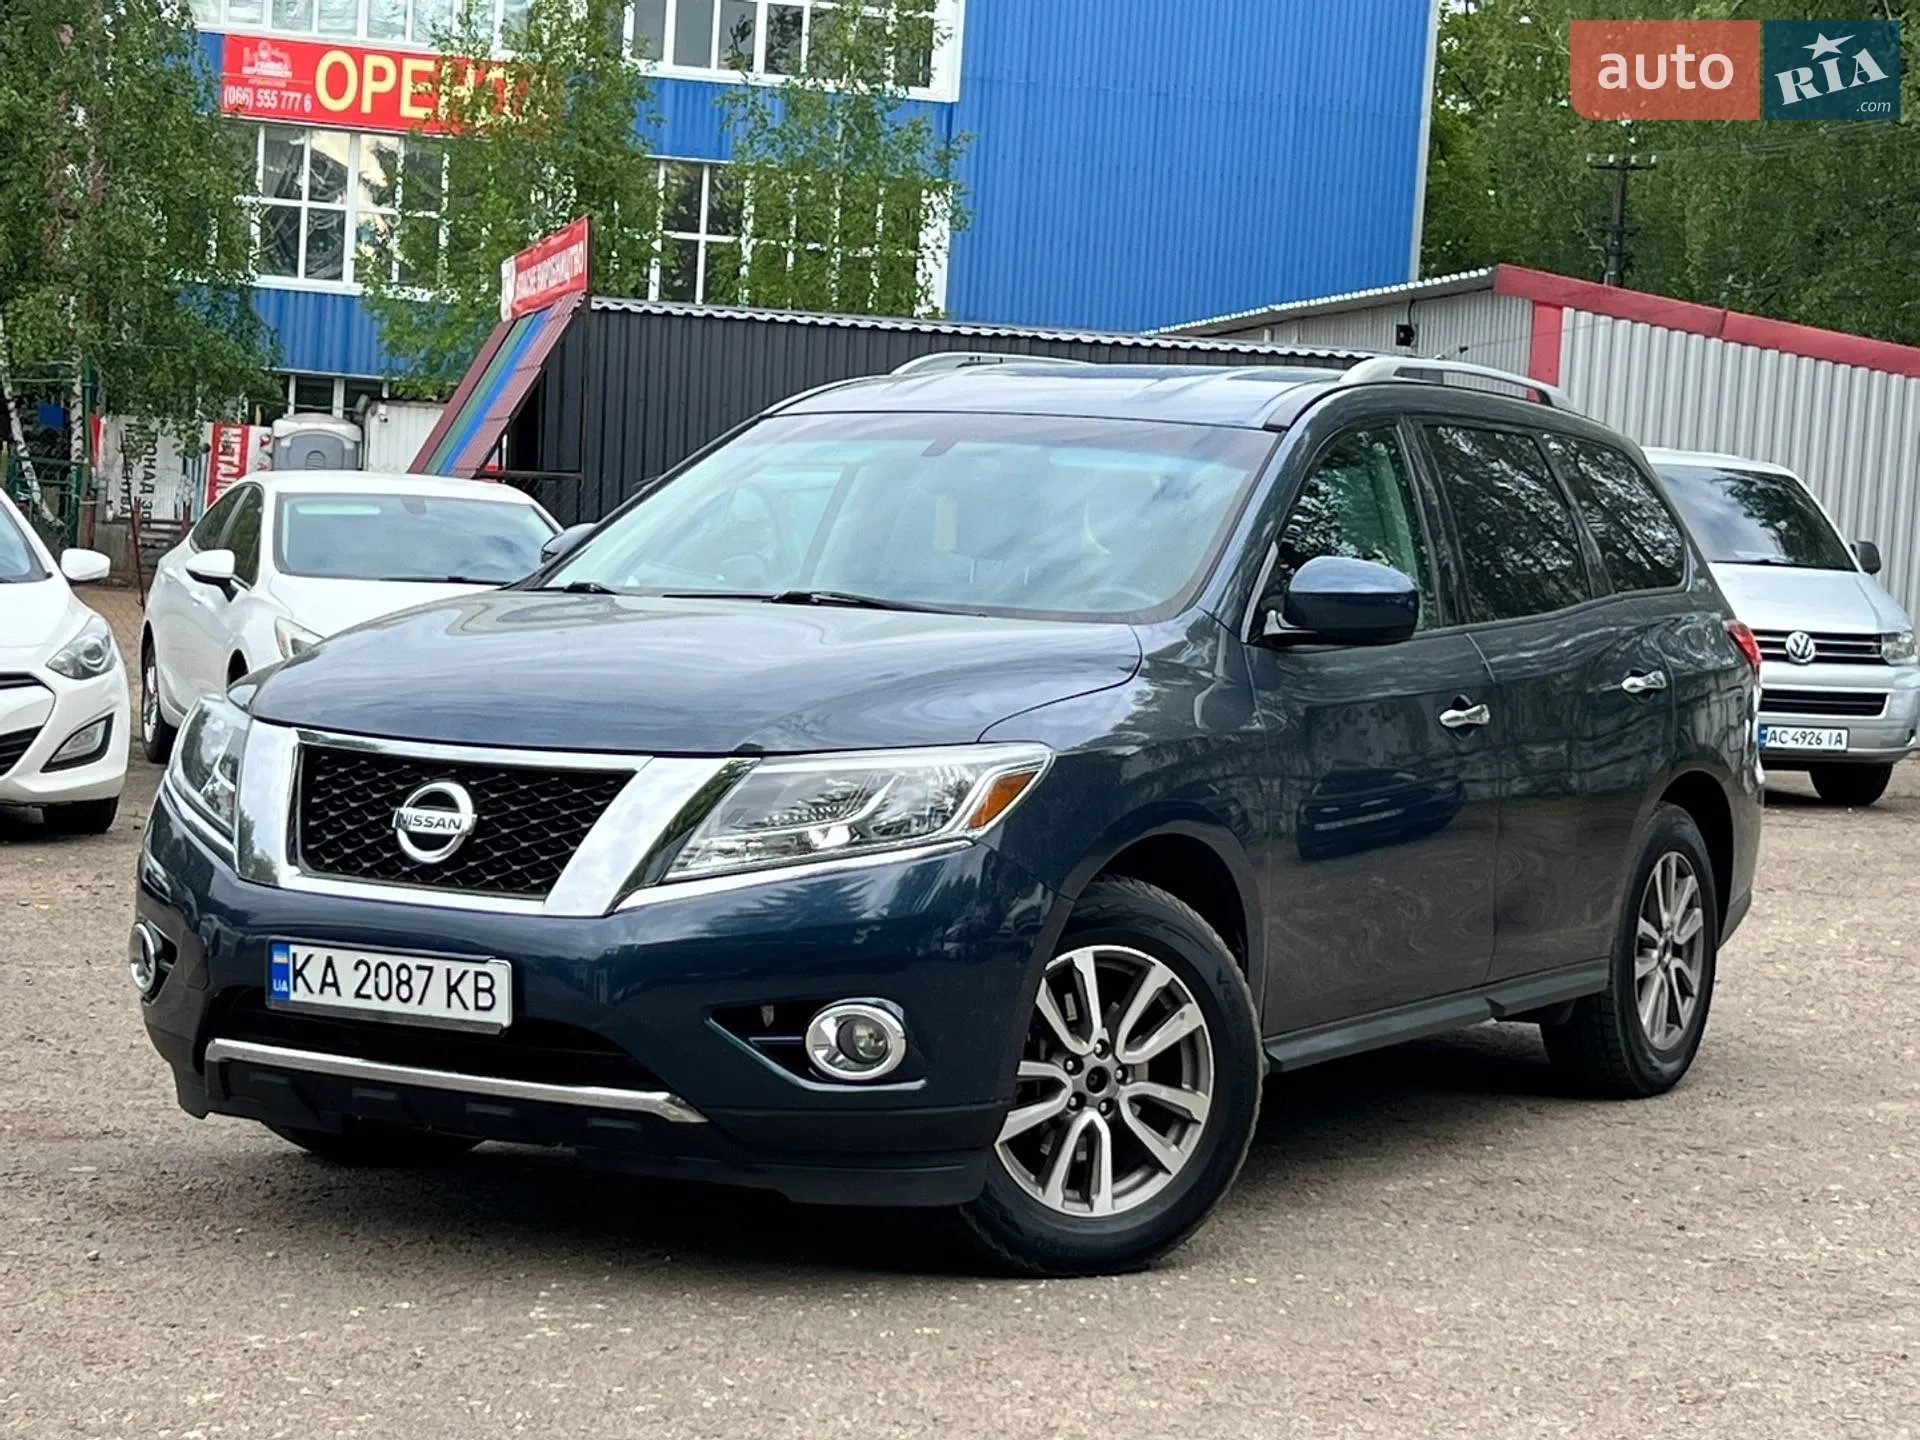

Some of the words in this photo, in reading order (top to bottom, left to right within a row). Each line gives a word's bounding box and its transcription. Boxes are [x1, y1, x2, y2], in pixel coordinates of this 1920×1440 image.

[223, 85, 253, 110] (066)
[256, 88, 278, 109] 555
[280, 90, 302, 111] 777
[303, 92, 312, 113] 6
[1768, 730, 1789, 745] AC
[1791, 730, 1823, 746] 4926
[1828, 734, 1843, 746] IA
[397, 810, 463, 832] NISSAN
[273, 979, 288, 993] UA
[291, 952, 342, 997] KA
[353, 958, 434, 1006] 2087
[445, 968, 496, 1012] KB
